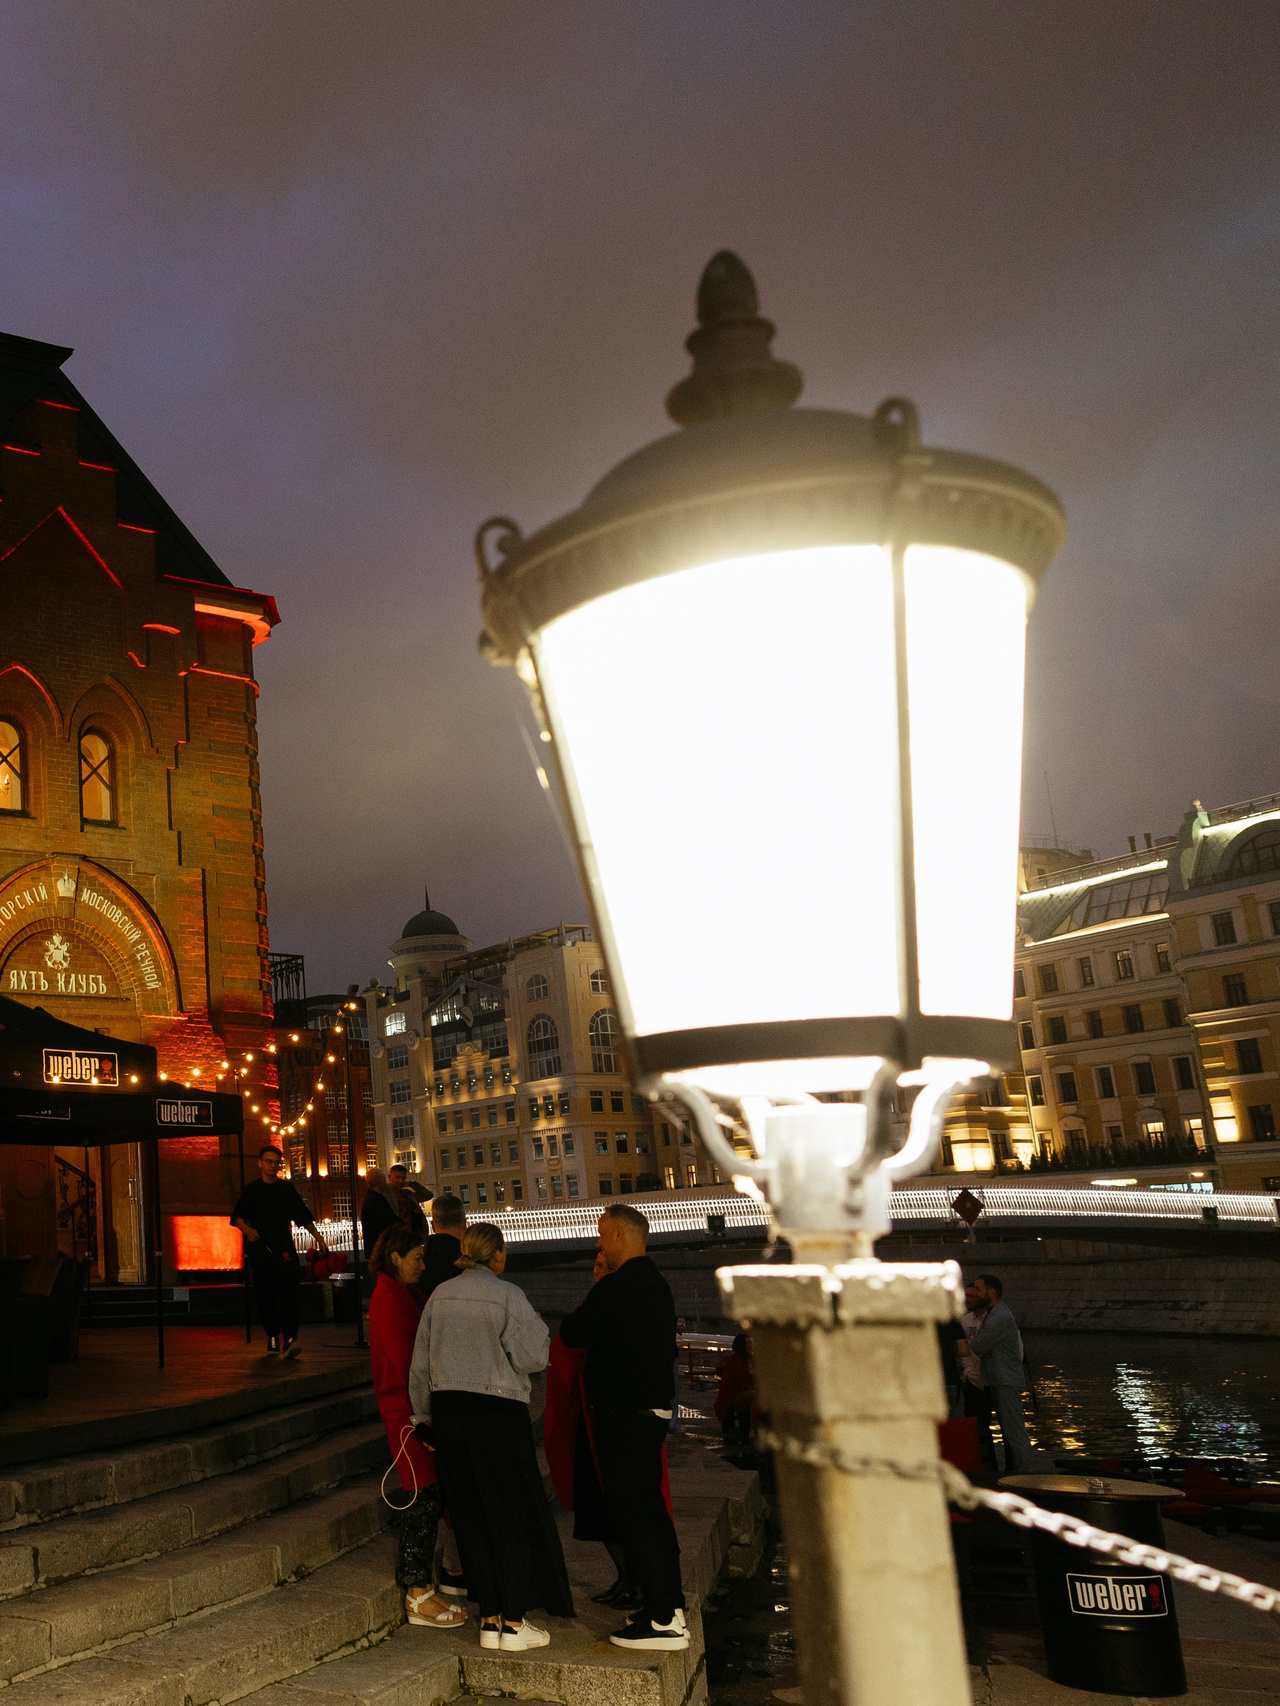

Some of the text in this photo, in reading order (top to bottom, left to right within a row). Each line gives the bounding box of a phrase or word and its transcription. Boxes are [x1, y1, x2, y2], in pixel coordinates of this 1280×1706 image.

[133, 942, 162, 990] РЕЧНОЙ
[10, 970, 107, 995] ЯХТЪ КЛУБЪ
[49, 1052, 100, 1081] weber
[161, 1101, 198, 1123] weber
[1074, 1577, 1147, 1611] weber
